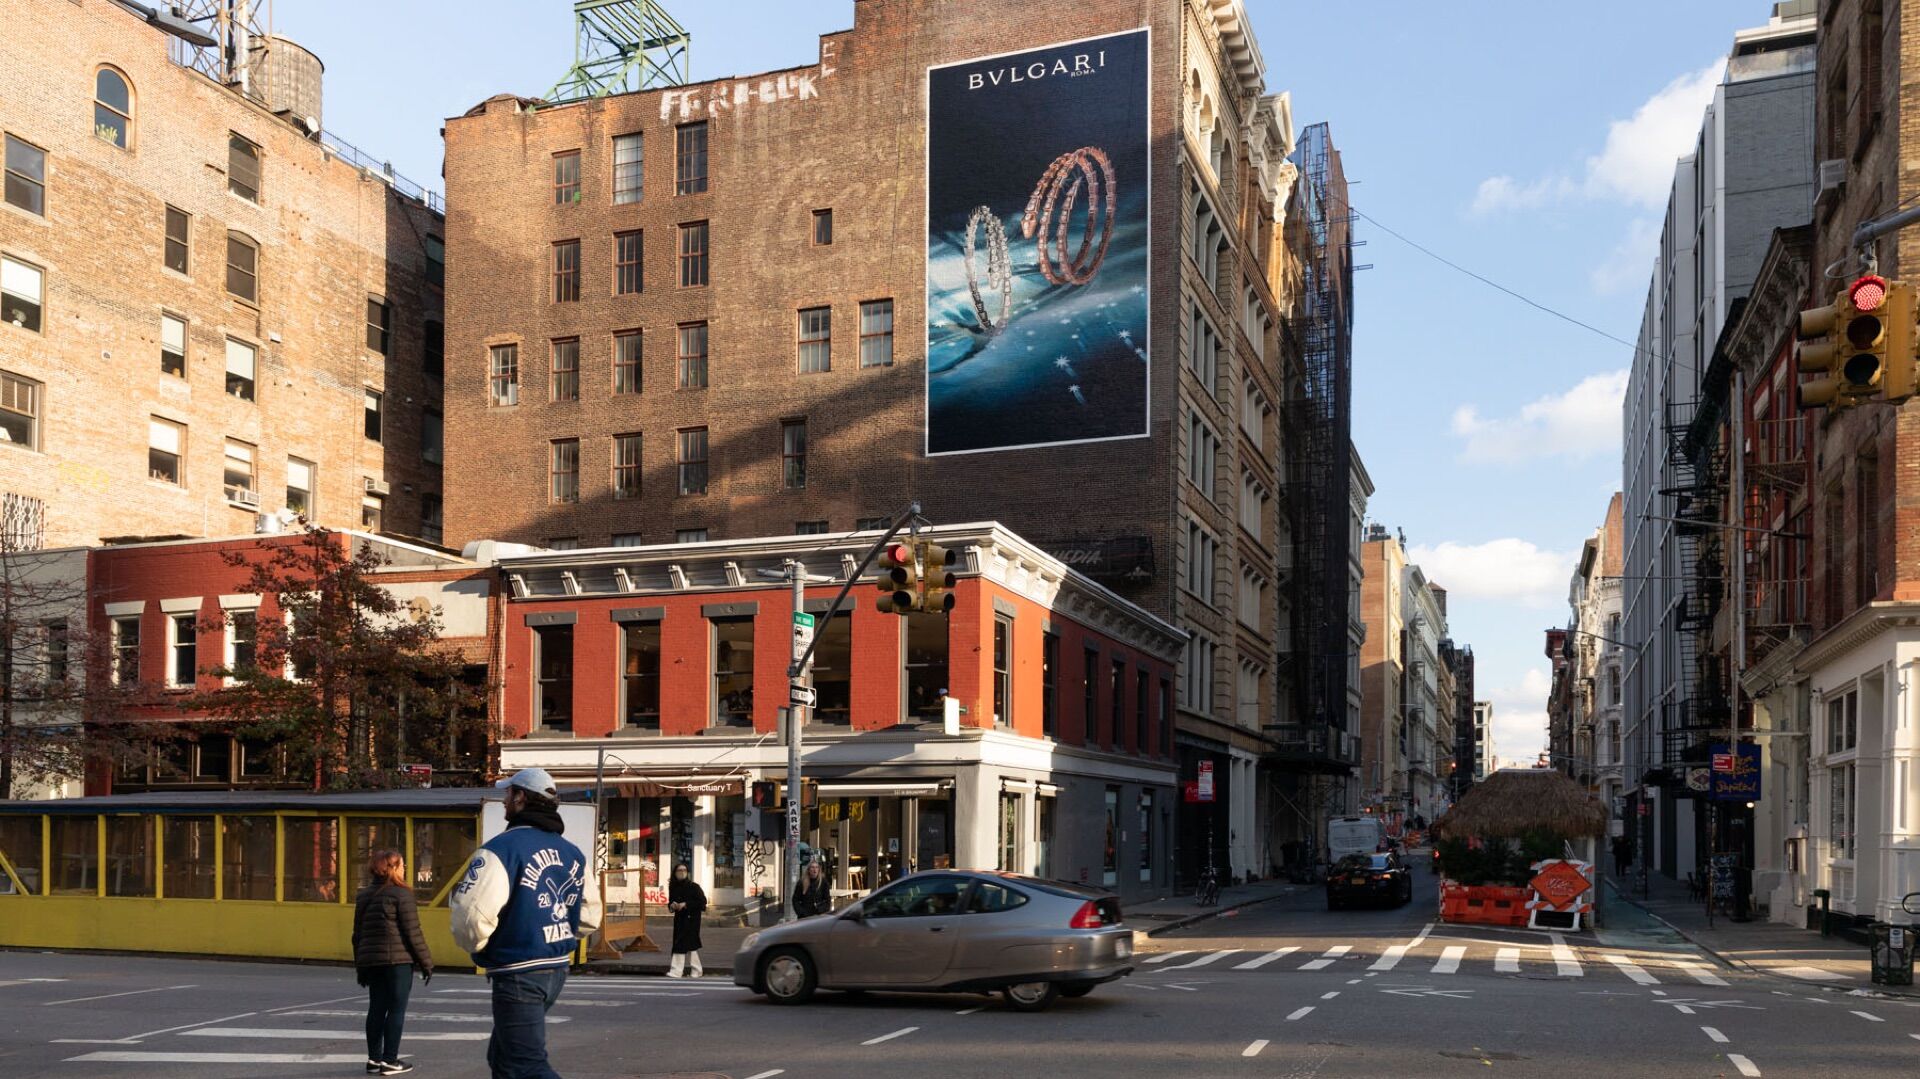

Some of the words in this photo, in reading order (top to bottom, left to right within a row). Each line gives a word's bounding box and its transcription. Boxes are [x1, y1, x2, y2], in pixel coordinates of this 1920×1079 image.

[968, 51, 1105, 90] BVLGARI
[1071, 69, 1096, 78] ROMA
[687, 784, 725, 793] Sanctuary
[726, 783, 732, 791] T
[819, 801, 866, 822] FLIPER'S
[520, 848, 564, 890] HOLMDEL
[543, 922, 574, 944] VARS
